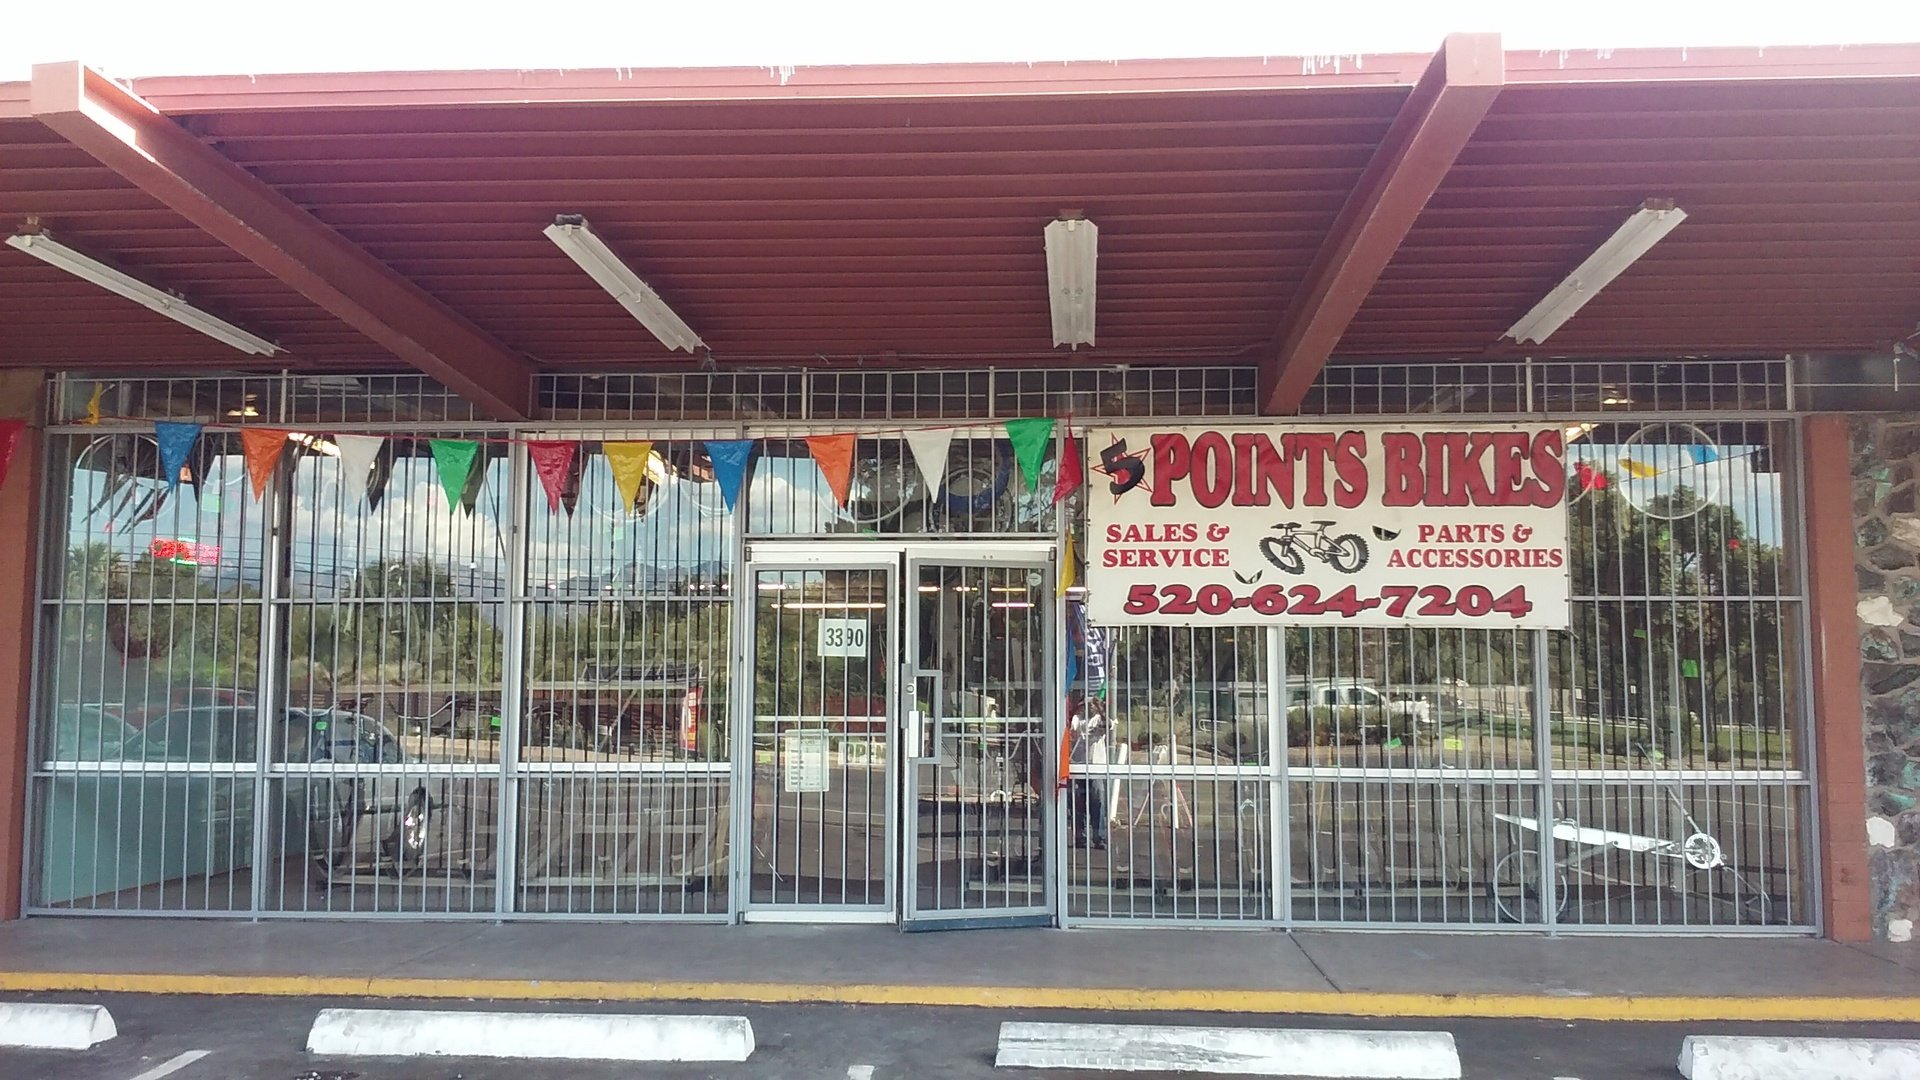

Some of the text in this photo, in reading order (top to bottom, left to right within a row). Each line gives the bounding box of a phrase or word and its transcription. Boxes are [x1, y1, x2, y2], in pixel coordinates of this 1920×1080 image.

[1100, 429, 1566, 510] 5 POINTS BIKES
[1106, 523, 1231, 543] SALES &
[1417, 523, 1533, 543] PARTS &
[1102, 548, 1230, 568] SERVICE
[1386, 548, 1563, 568] ACCESSORIES
[1123, 584, 1533, 619] 520-624-7204
[825, 627, 864, 647] 3390
[843, 743, 886, 760] OPN
